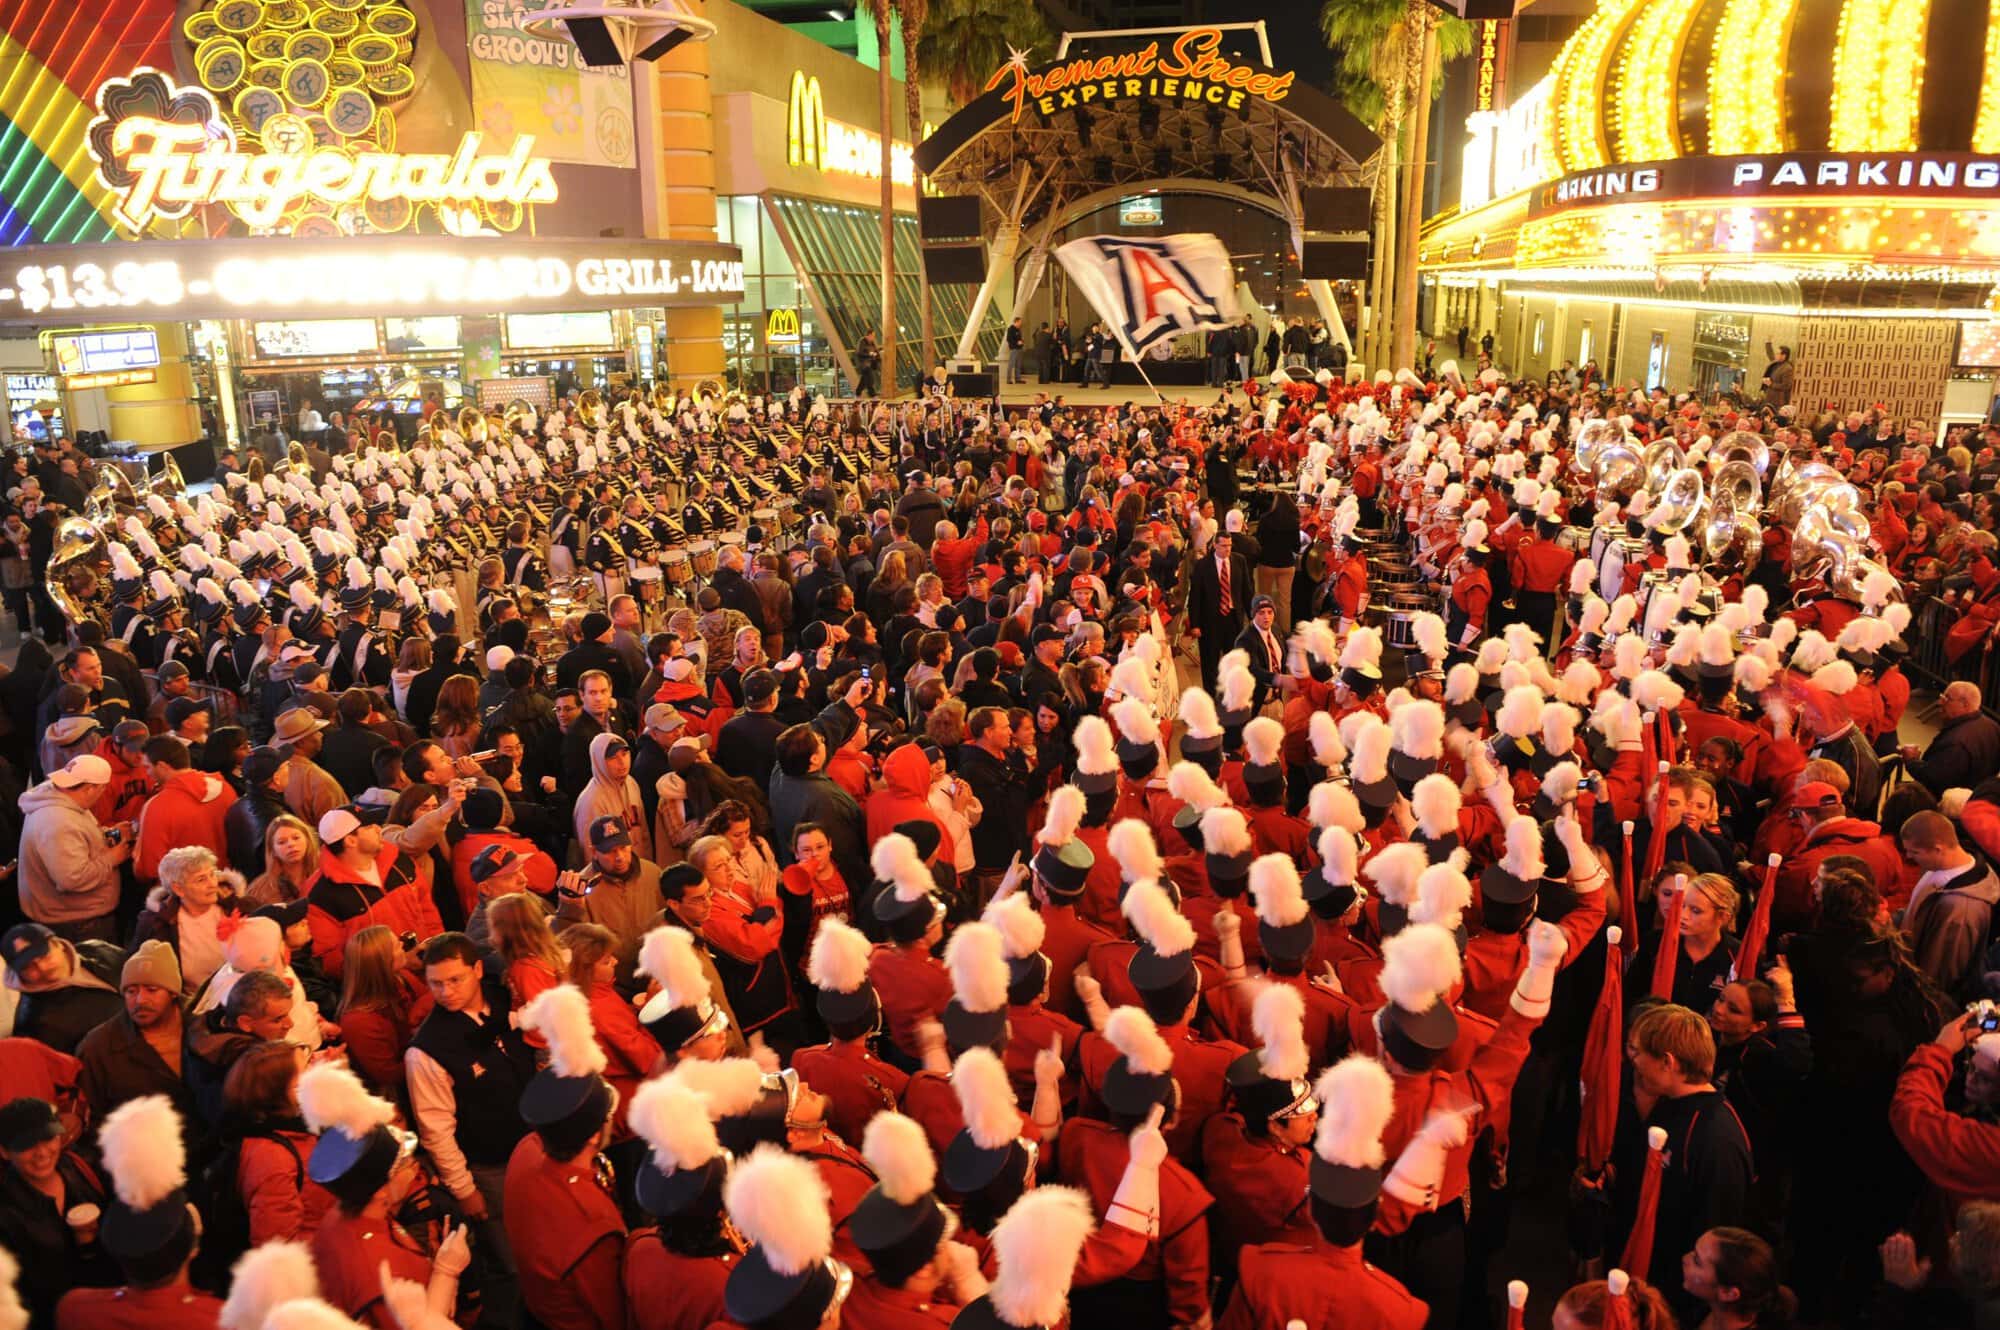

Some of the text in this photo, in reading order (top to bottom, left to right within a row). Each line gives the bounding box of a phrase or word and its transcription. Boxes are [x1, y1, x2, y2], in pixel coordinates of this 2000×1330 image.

[472, 34, 568, 69] GROOVY
[984, 28, 1295, 124] Fremont Street
[1039, 78, 1246, 116] EXPERIENCE
[1556, 169, 1660, 202] PARKING
[1733, 160, 2000, 188] PARKING
[16, 262, 184, 313] $13.95
[576, 259, 679, 295] GRILL
